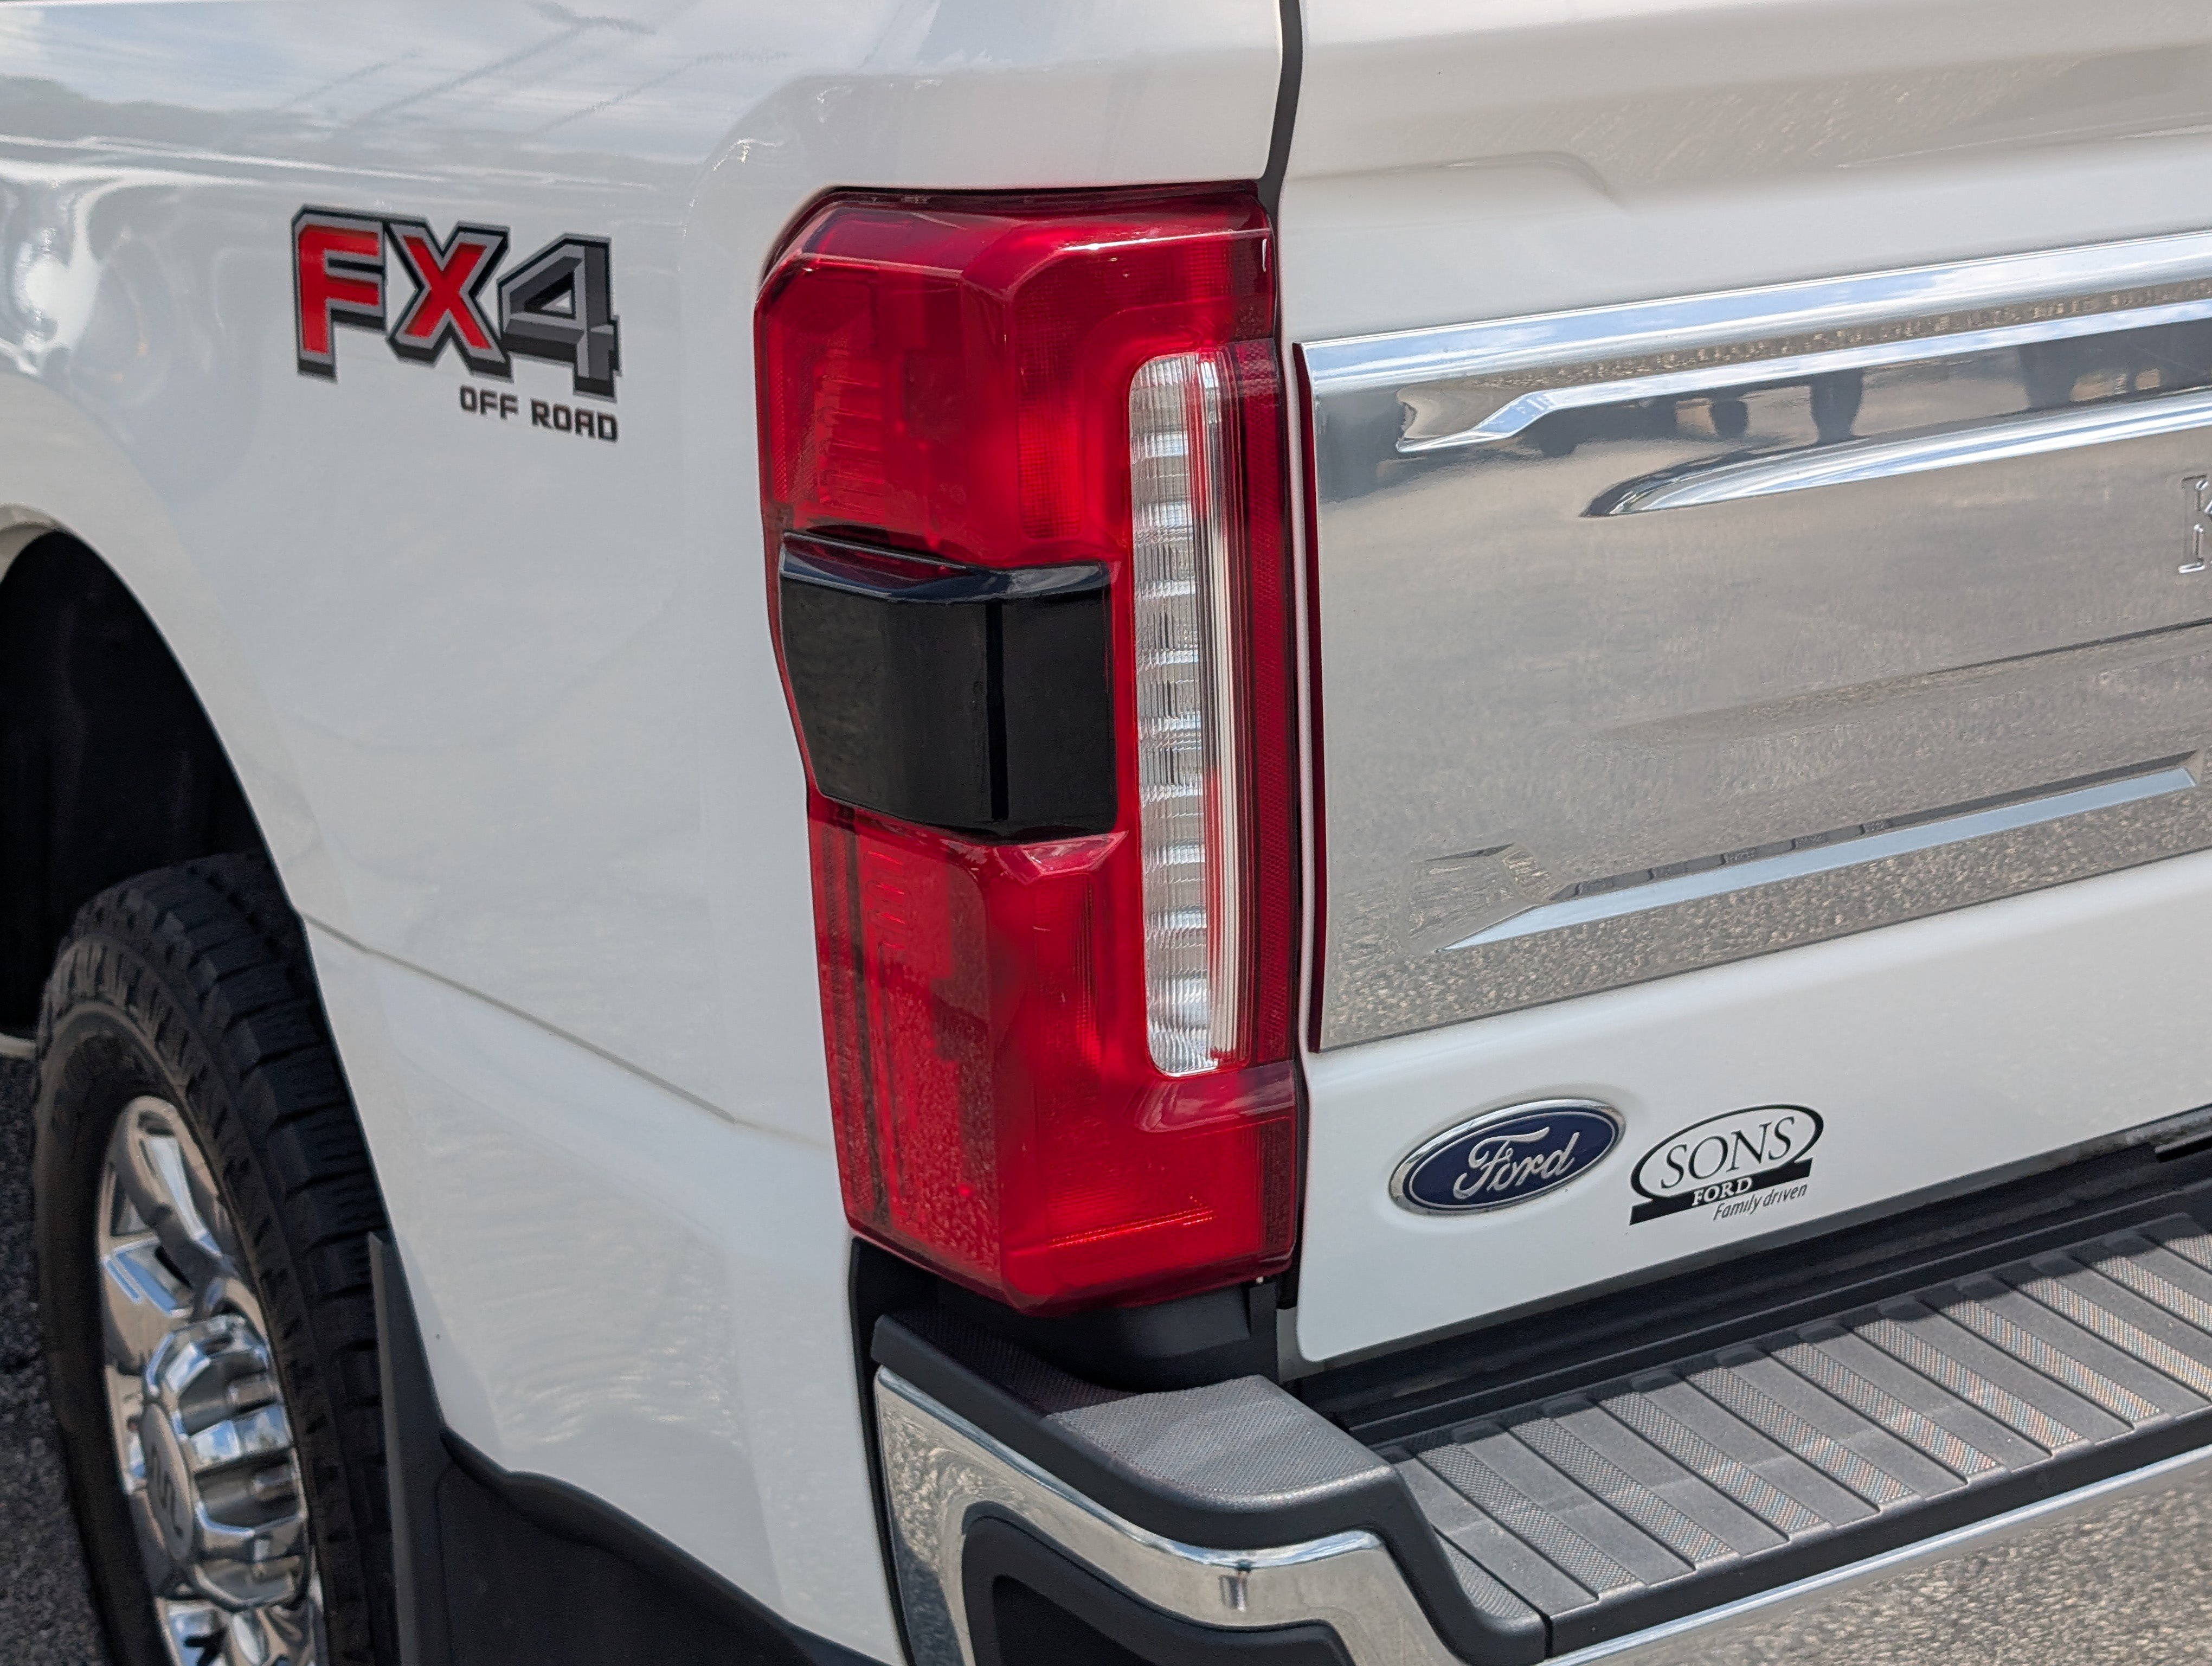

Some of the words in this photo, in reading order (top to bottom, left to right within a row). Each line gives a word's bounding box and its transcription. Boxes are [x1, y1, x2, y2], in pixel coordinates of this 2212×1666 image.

[292, 204, 621, 402] FX4
[460, 385, 518, 421] OFF
[531, 399, 619, 443] ROAD
[1452, 1126, 1581, 1200] Ford
[1660, 1116, 1795, 1189] SONS
[1691, 1177, 1753, 1207] FORD
[1713, 1194, 1762, 1221] Family
[1763, 1184, 1808, 1207] driven
